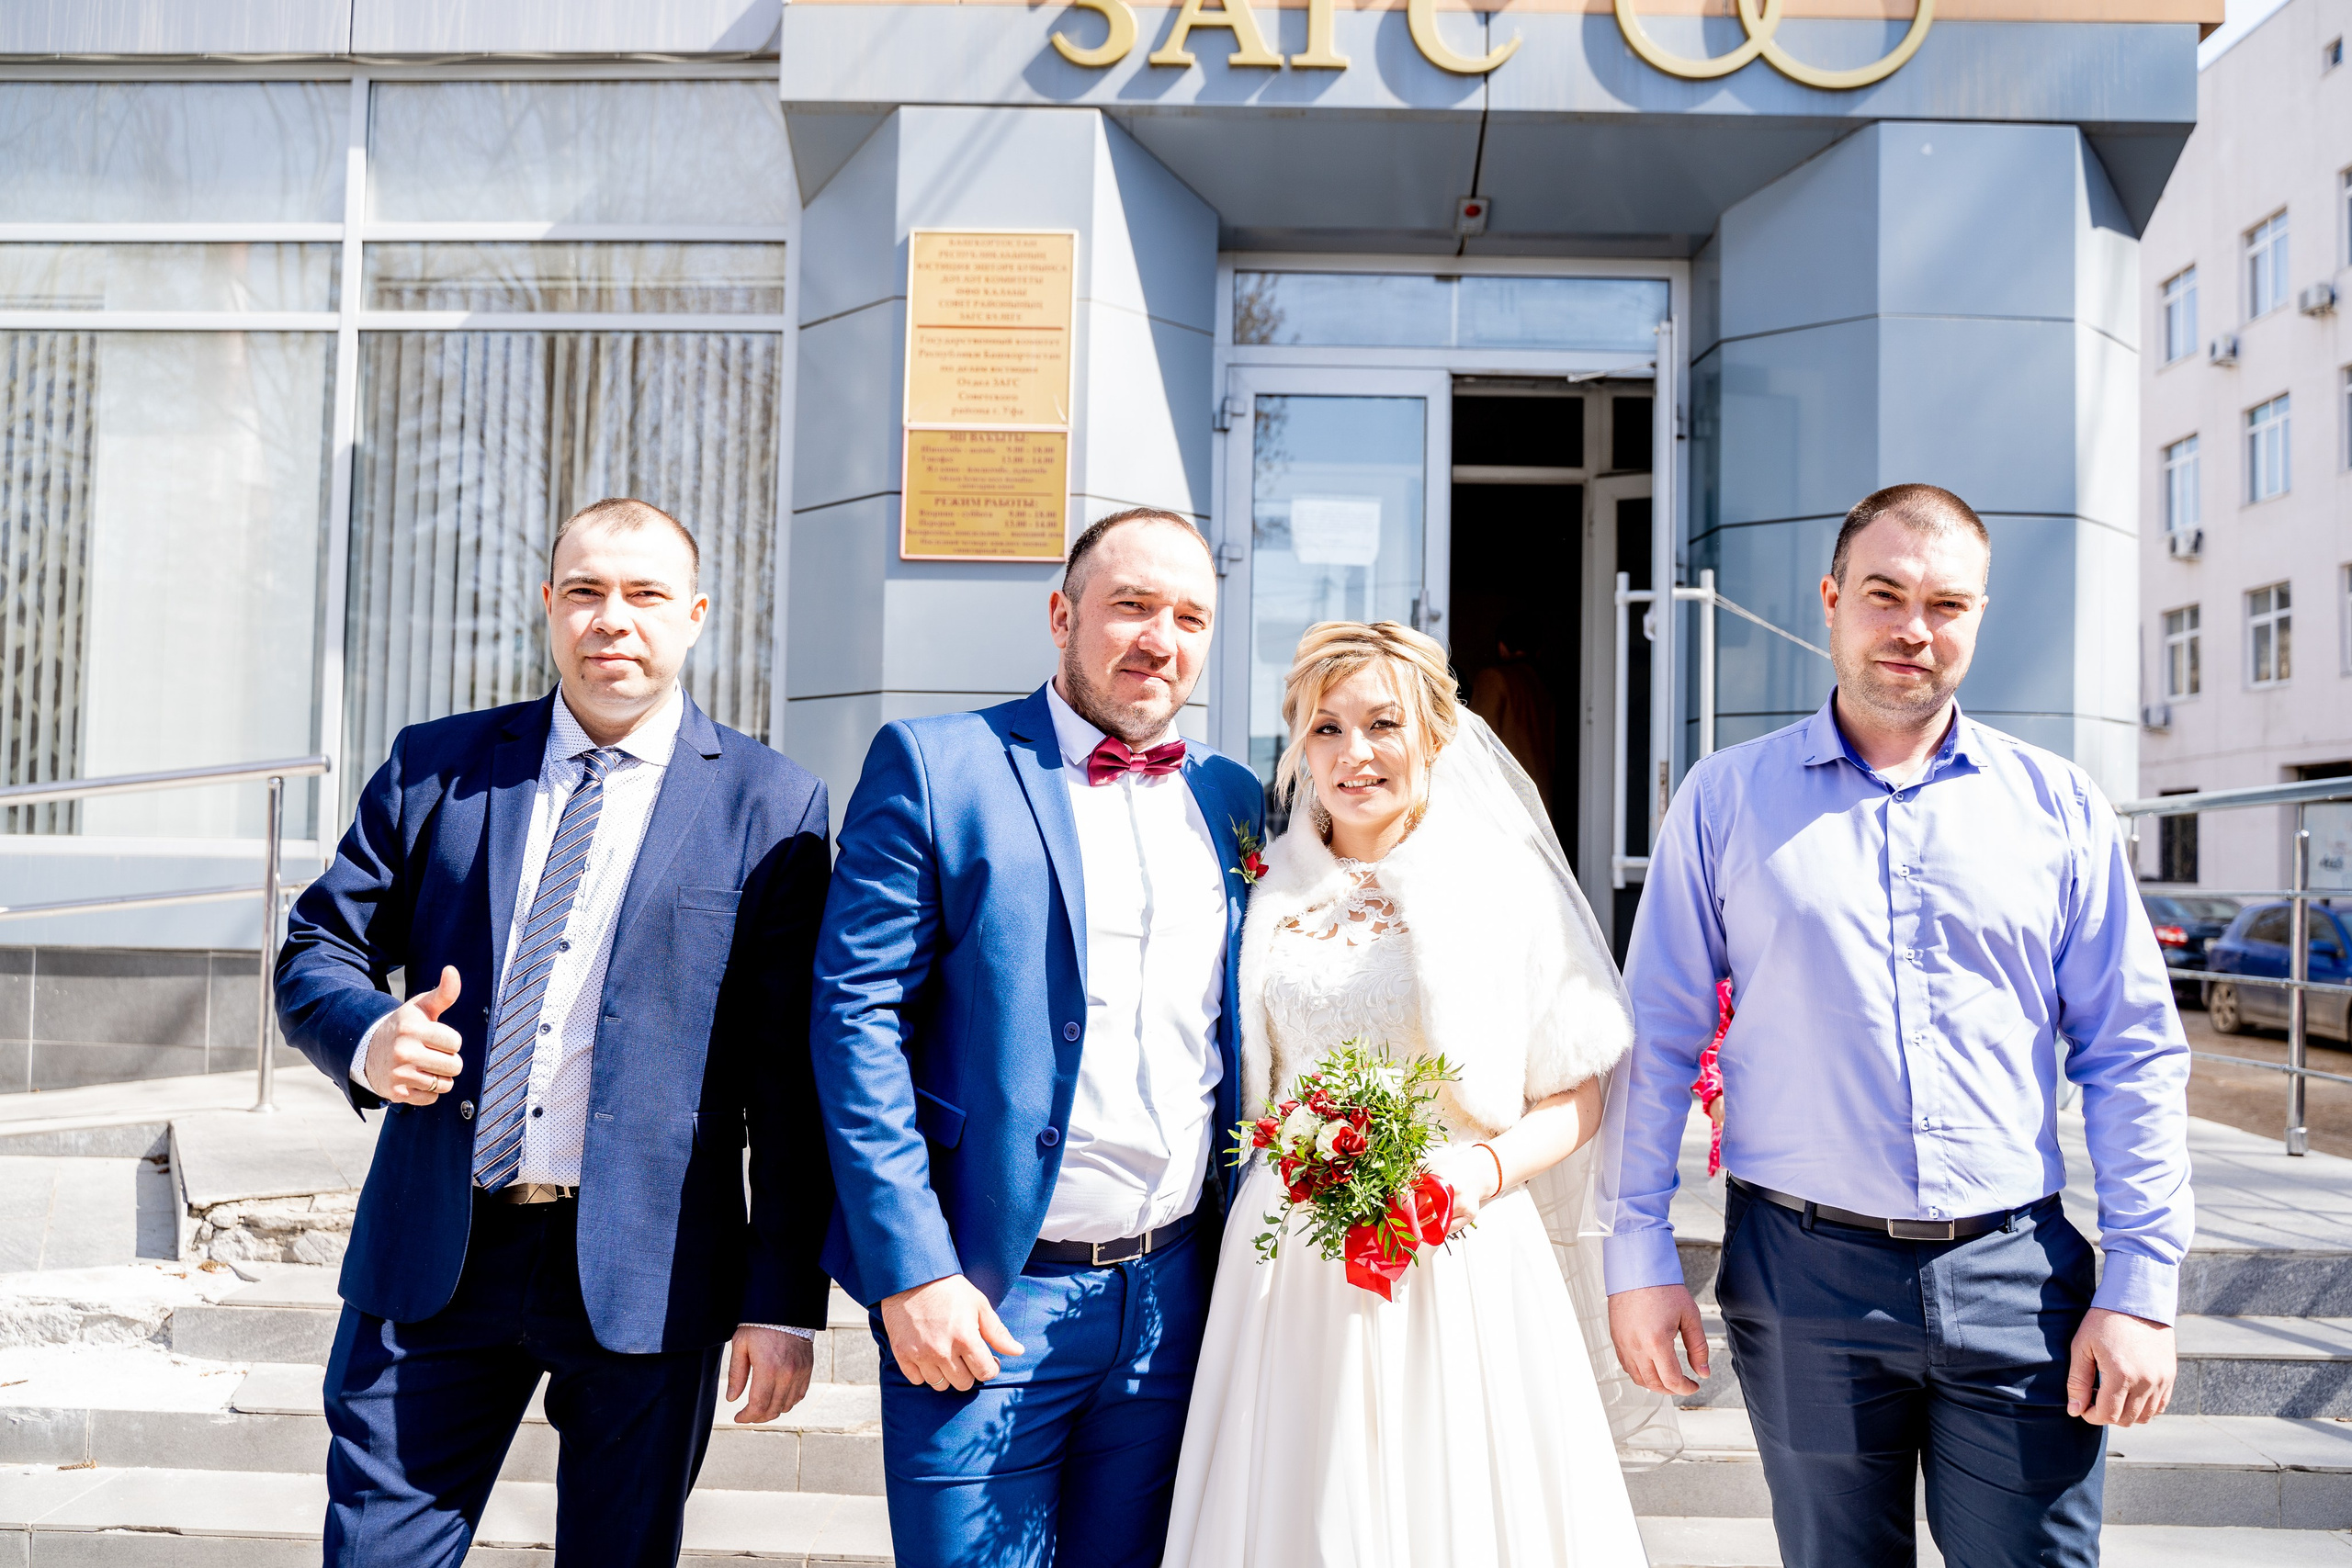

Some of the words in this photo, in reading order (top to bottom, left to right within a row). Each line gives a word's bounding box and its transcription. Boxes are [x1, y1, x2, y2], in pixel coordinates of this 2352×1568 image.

[920, 336, 1013, 346] Государственный
[919, 350, 981, 359] Республики
[984, 351, 1061, 361] Башкортостан
[957, 378, 989, 387] Отдел
[994, 378, 1020, 387] ЗАГС
[934, 497, 981, 506] РЕЖИМ
[984, 498, 1038, 506] РАБОТЫ:
